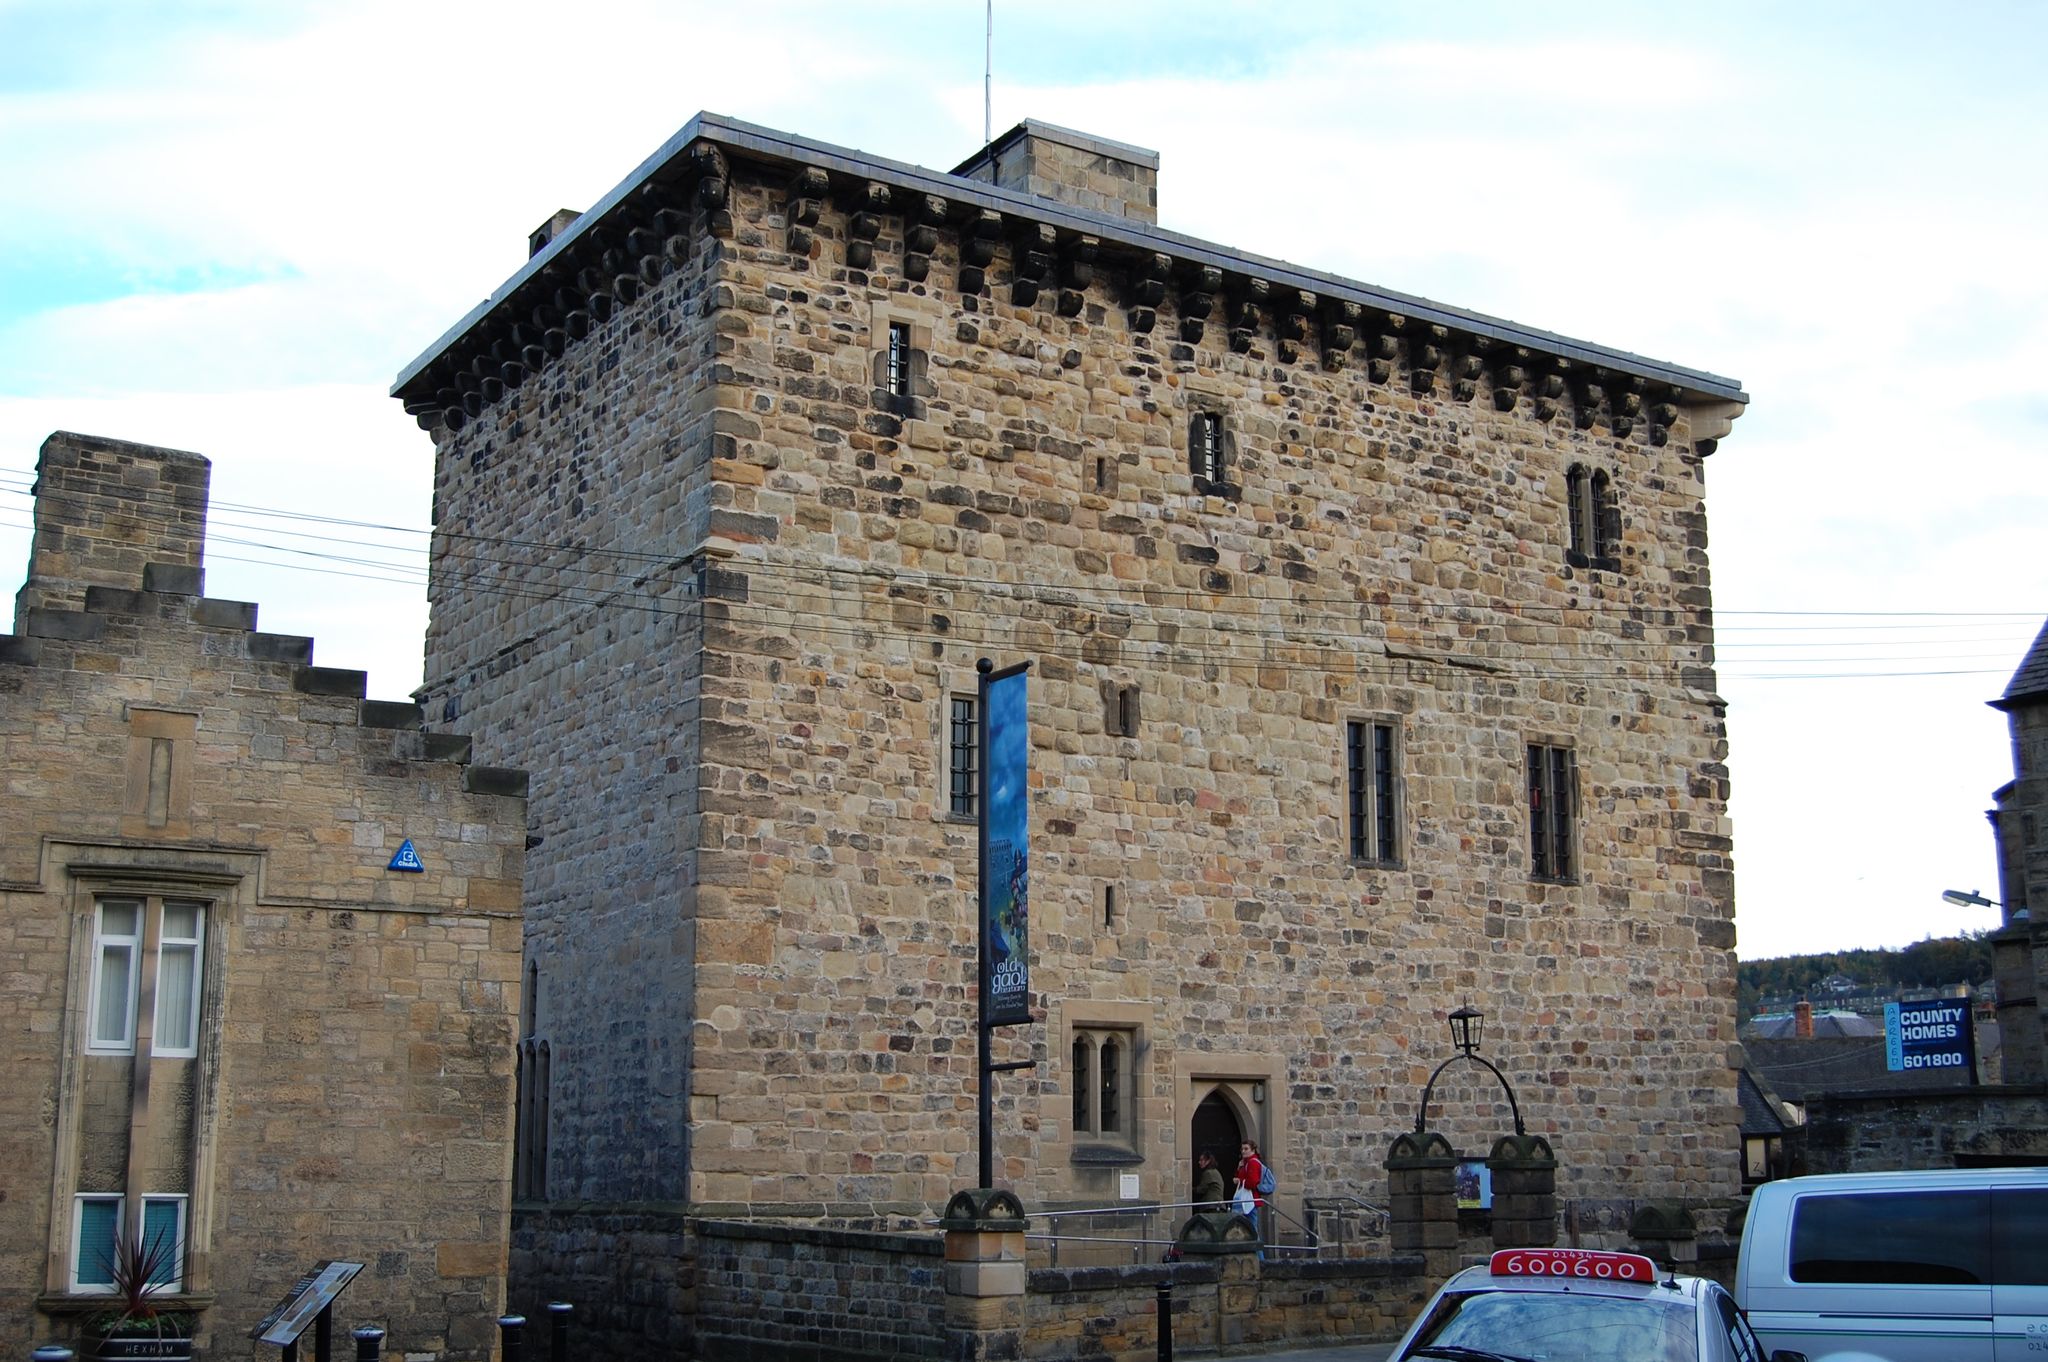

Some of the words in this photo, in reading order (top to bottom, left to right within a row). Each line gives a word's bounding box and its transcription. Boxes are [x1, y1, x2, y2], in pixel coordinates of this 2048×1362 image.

[997, 957, 1018, 973] old
[992, 966, 1028, 994] gaol
[1901, 1008, 1962, 1025] COUNTY
[1901, 1024, 1957, 1041] HOMES
[1903, 1053, 1962, 1068] 601800
[1552, 1250, 1593, 1260] 01434
[1507, 1255, 1636, 1279] 600600
[125, 1344, 174, 1354] HEXHAM
